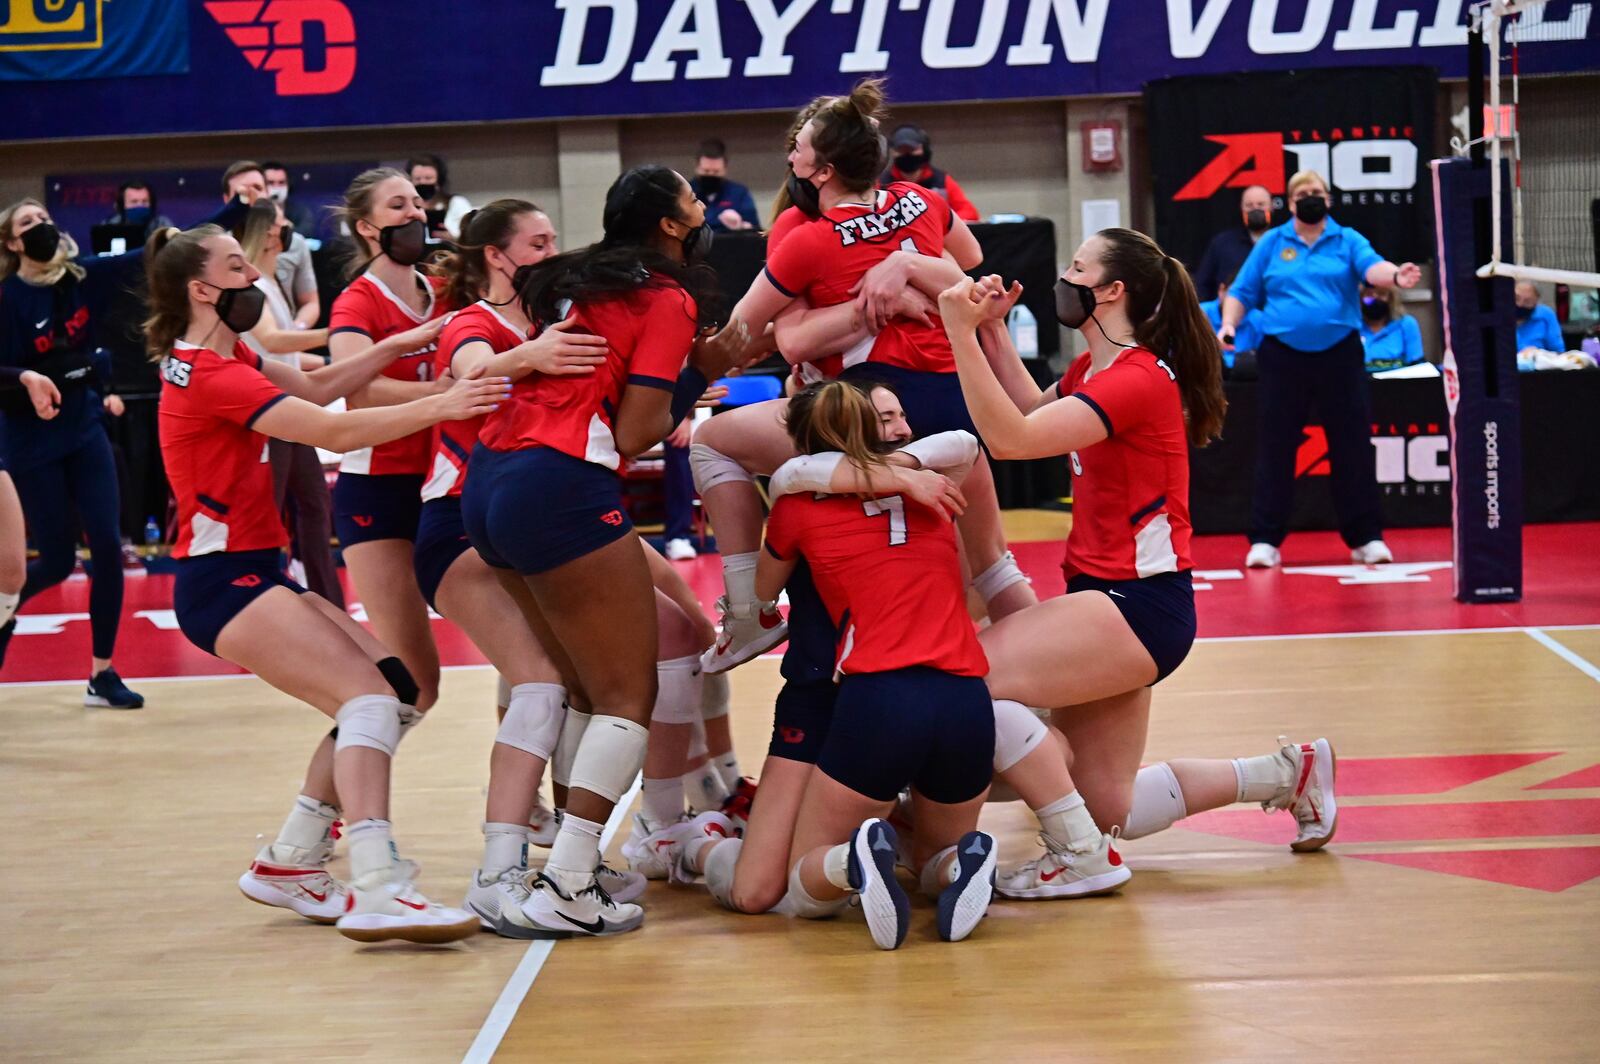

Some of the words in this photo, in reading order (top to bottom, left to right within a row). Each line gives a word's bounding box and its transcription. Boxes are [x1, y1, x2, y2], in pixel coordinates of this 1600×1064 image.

[539, 0, 1109, 87] DAYTON
[834, 190, 929, 247] FLYERS
[1484, 421, 1499, 470] sports
[862, 494, 907, 547] 7
[1485, 470, 1501, 530] imports
